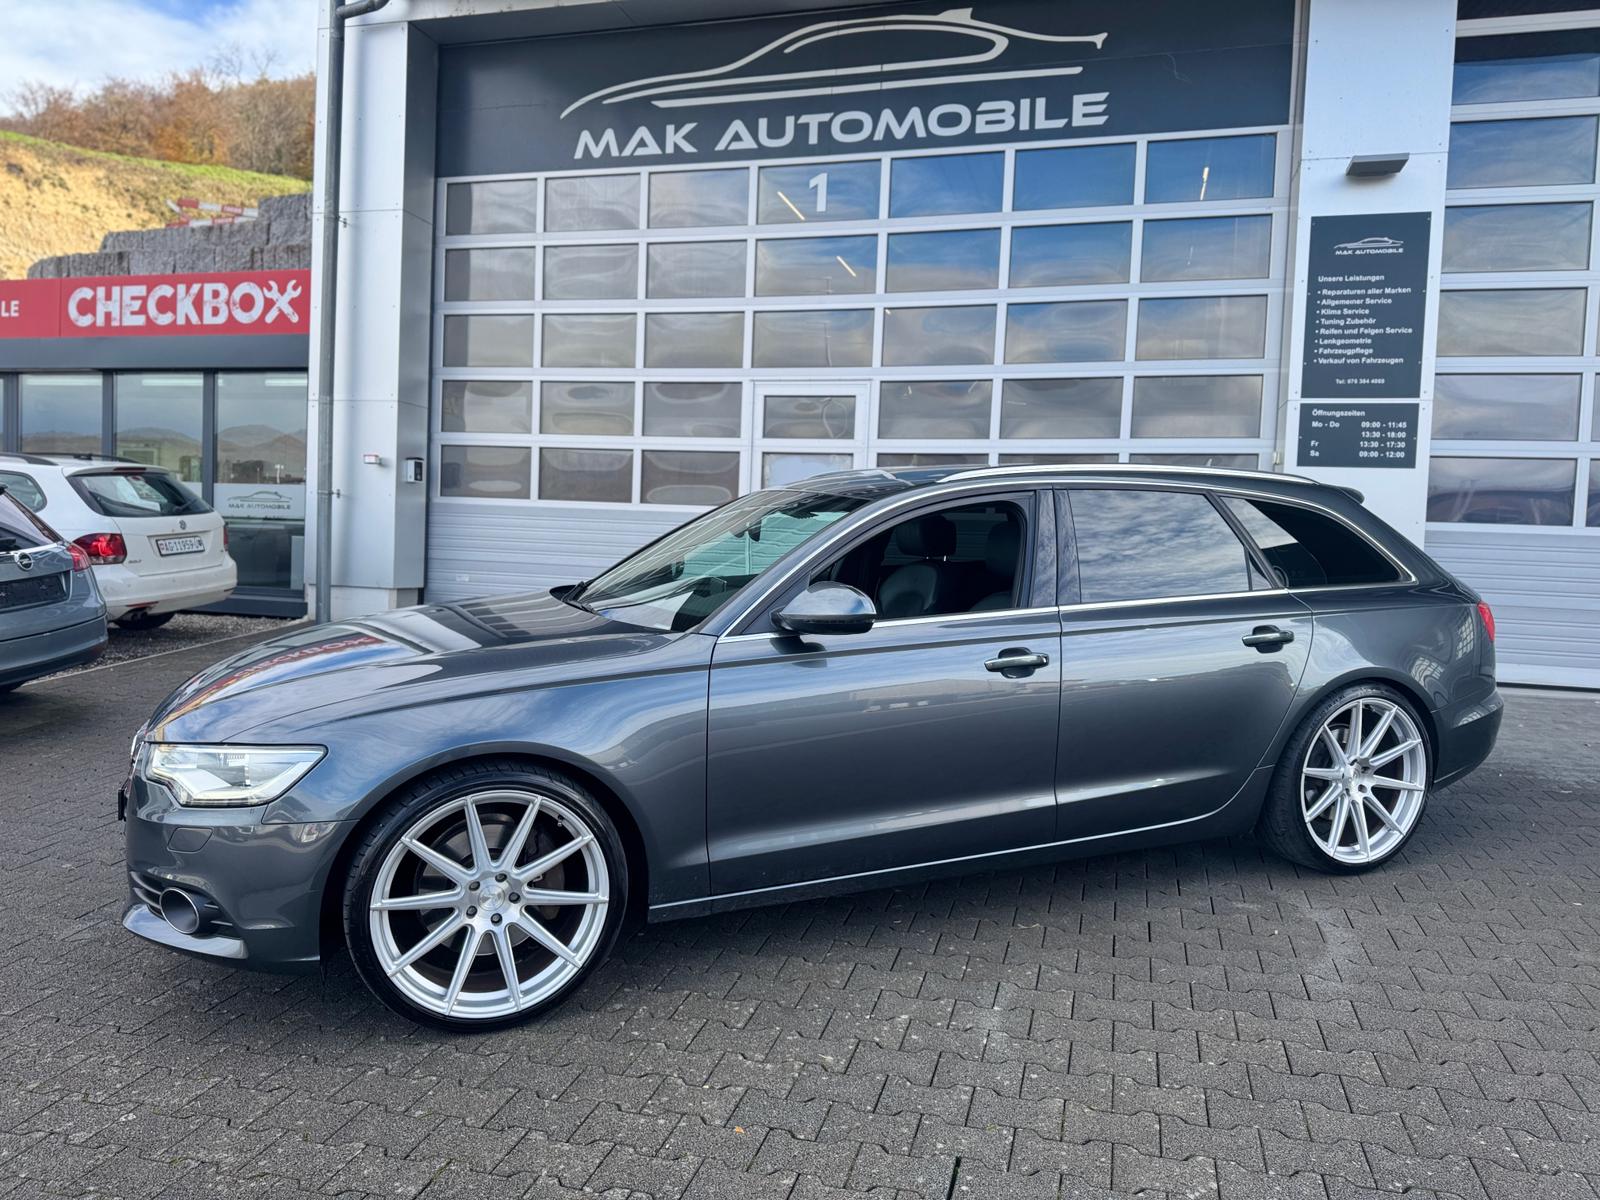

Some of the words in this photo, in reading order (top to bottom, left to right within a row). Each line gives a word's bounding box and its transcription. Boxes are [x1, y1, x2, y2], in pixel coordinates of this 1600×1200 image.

[574, 123, 698, 160] MAK
[714, 92, 1110, 152] AUTOMOBILE
[808, 173, 828, 212] 1
[1319, 337, 1372, 345] Lenkgeometrie
[1312, 409, 1365, 417] Öffnungszeiten
